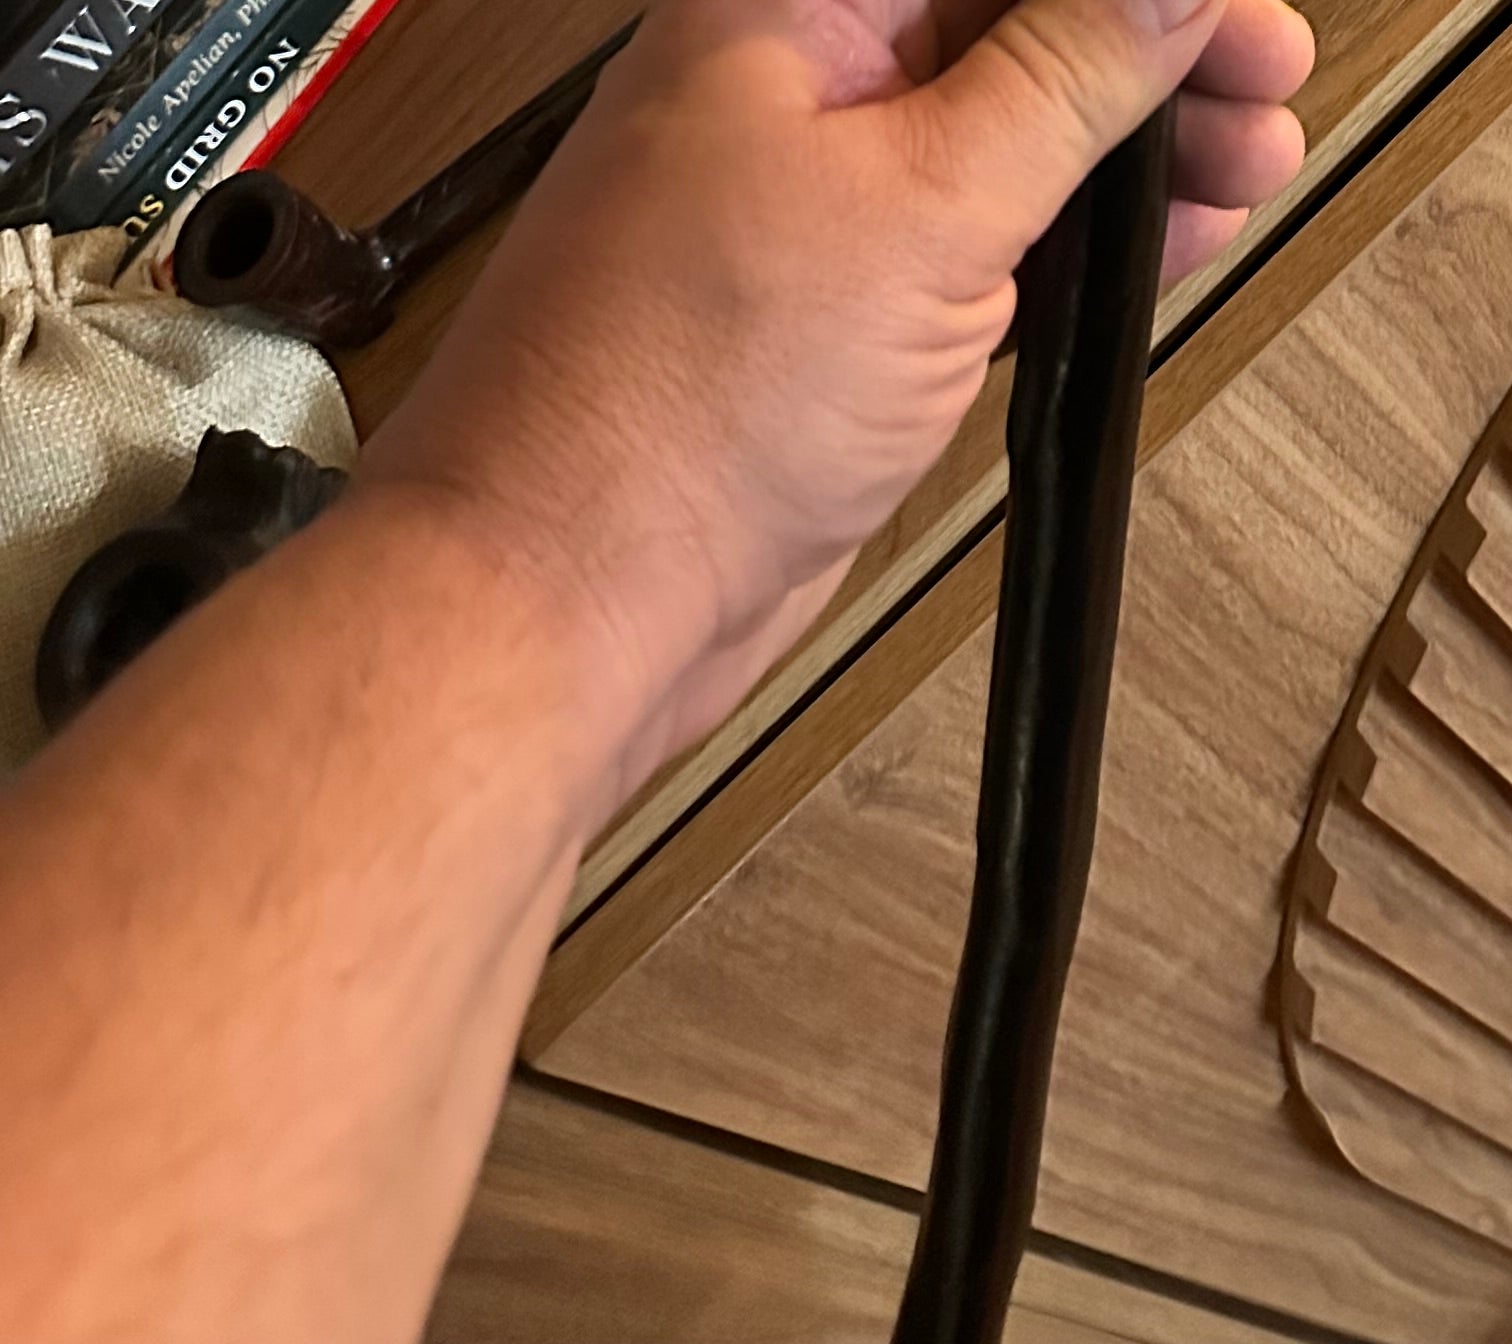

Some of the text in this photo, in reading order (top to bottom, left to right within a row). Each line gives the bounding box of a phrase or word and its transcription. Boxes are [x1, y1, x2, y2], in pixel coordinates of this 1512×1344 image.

[98, 114, 162, 183] Nicole
[162, 29, 243, 116] Apelian,
[249, 37, 301, 93] NO
[165, 99, 248, 192] GRID
